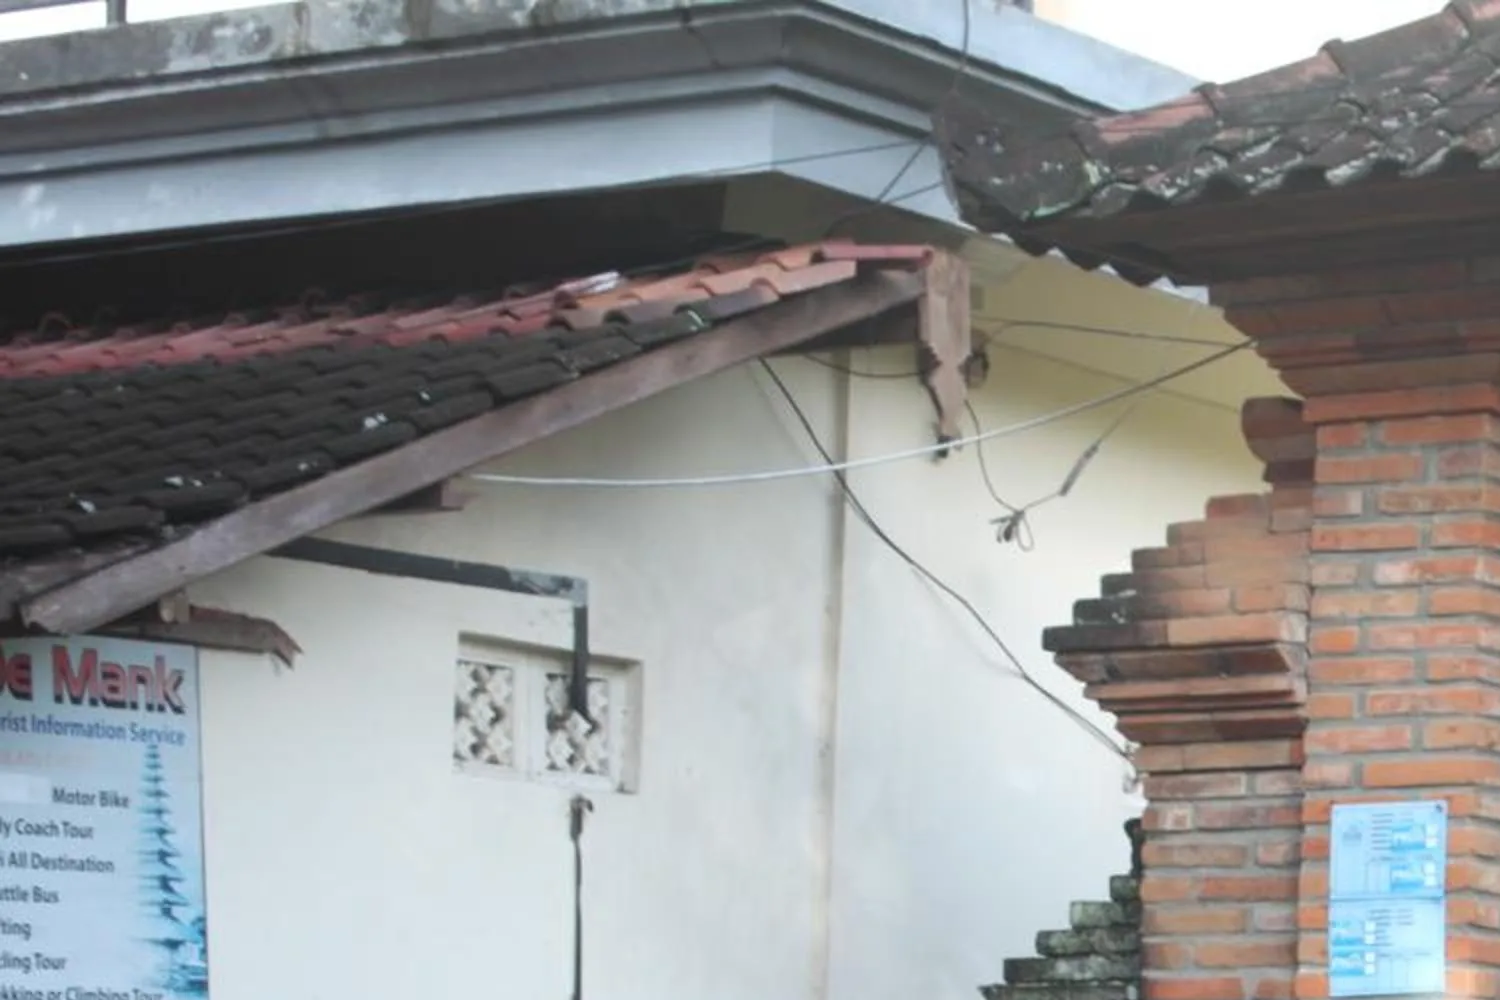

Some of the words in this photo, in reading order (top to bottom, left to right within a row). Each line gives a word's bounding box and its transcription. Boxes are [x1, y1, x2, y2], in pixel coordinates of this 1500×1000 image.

[52, 645, 186, 714] Mank
[31, 714, 126, 741] Information
[130, 721, 186, 746] Service
[52, 787, 96, 806] Motor
[99, 789, 129, 808] Bike
[15, 817, 60, 837] Coach
[62, 821, 94, 839] Tour
[8, 851, 27, 868] All
[31, 852, 115, 872] Destination
[33, 886, 59, 903] Bus
[34, 952, 66, 970] Tour
